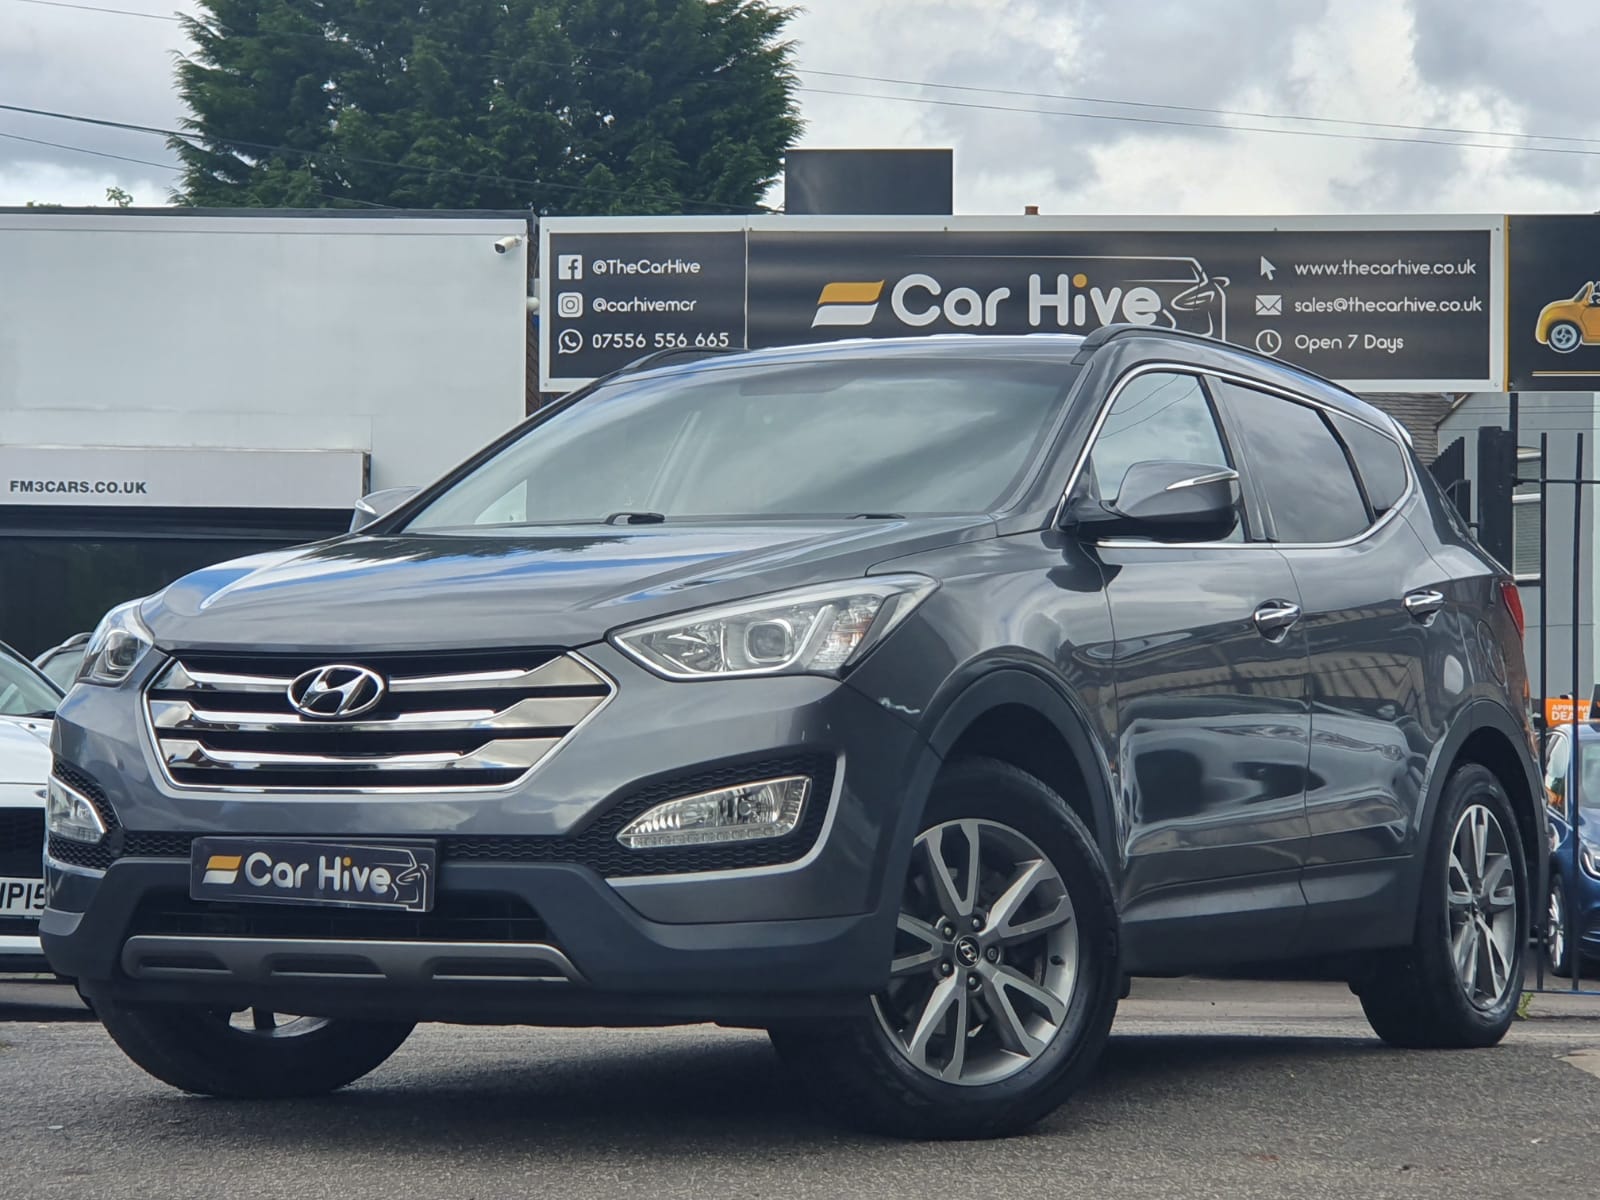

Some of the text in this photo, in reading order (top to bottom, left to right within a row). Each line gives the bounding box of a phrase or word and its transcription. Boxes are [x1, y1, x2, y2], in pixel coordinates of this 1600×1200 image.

[592, 259, 701, 274] @TheCarHive
[1294, 259, 1477, 276] www.thecarhive.co.uk
[592, 296, 697, 312] @carhivemcr
[891, 273, 1162, 327] Car Hive
[1294, 296, 1482, 313] sales@thecarhive.co.uk
[592, 332, 729, 348] 07556 556 665
[1294, 334, 1404, 354] Open 7 Days
[9, 480, 147, 494] FM3CARS.CO.UK
[245, 852, 392, 894] Car Hive
